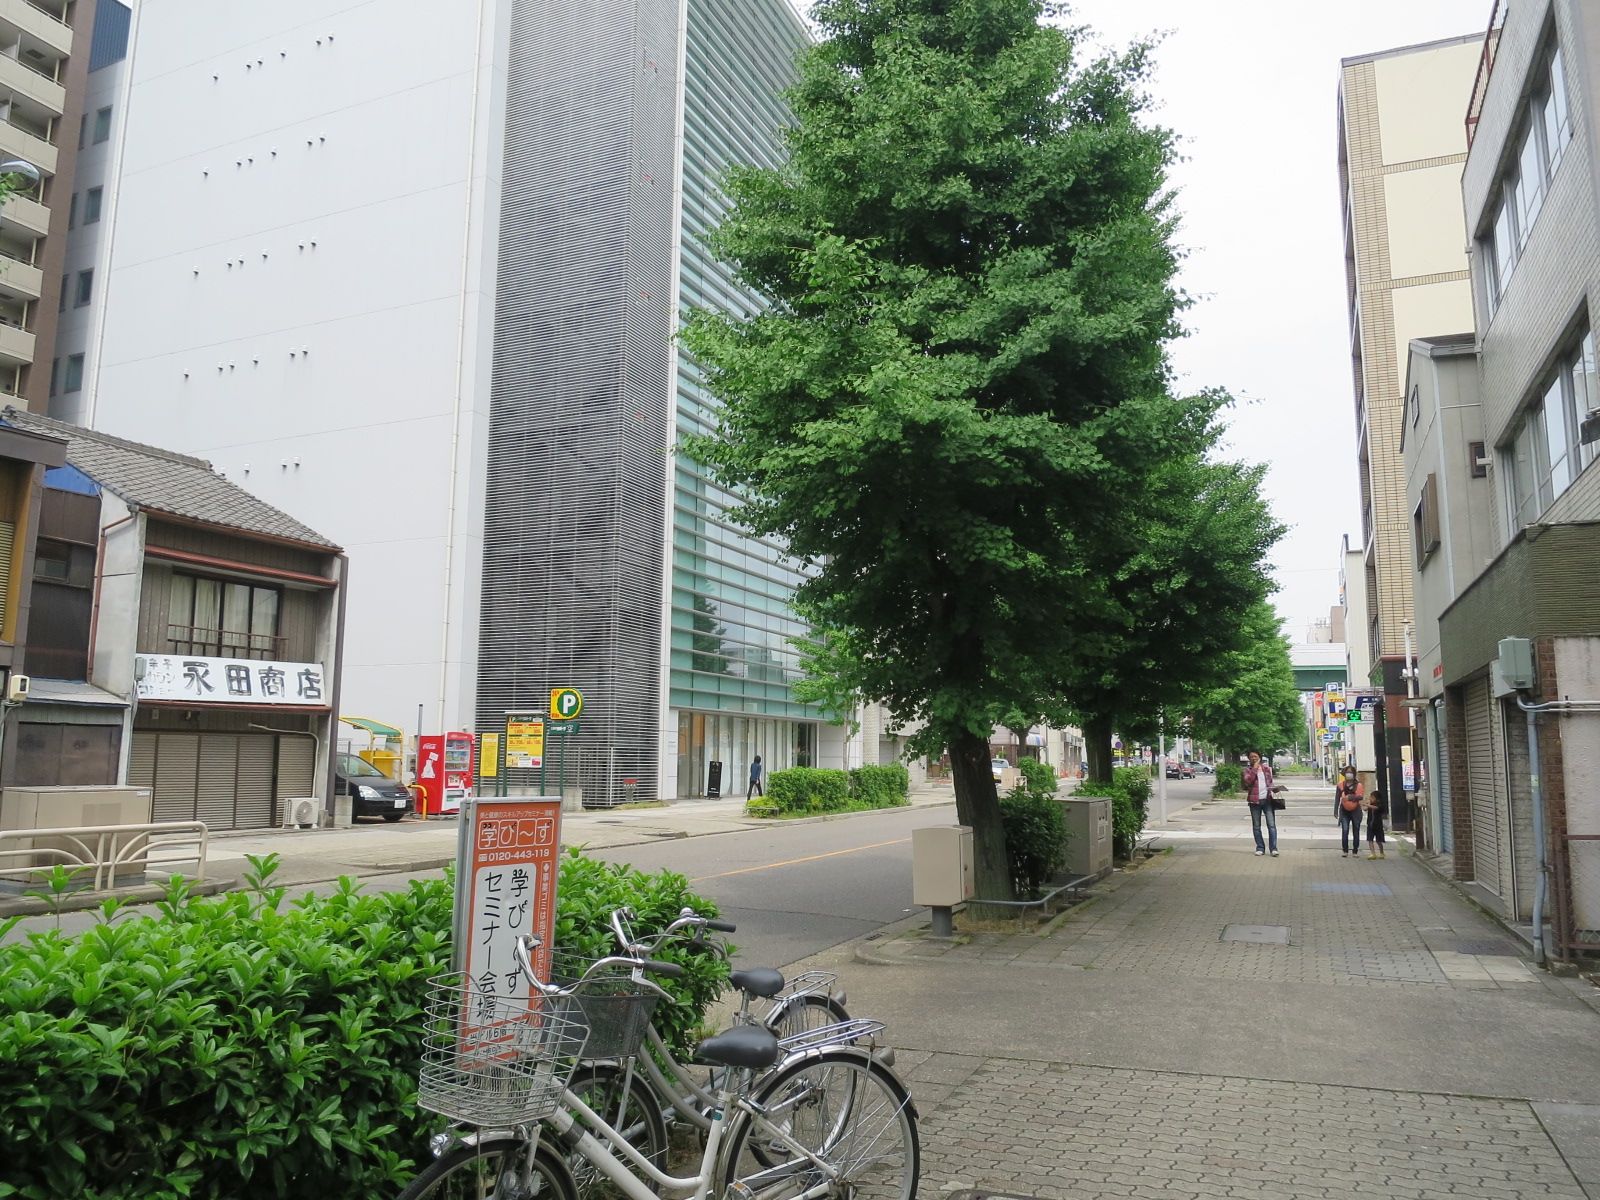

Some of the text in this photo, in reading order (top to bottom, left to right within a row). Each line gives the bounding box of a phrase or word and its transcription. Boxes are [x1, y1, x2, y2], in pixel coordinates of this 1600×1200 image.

[182, 660, 321, 699] 永田商店
[562, 694, 576, 714] P
[1335, 702, 1345, 714] P
[488, 848, 550, 862] 0120-443-119
